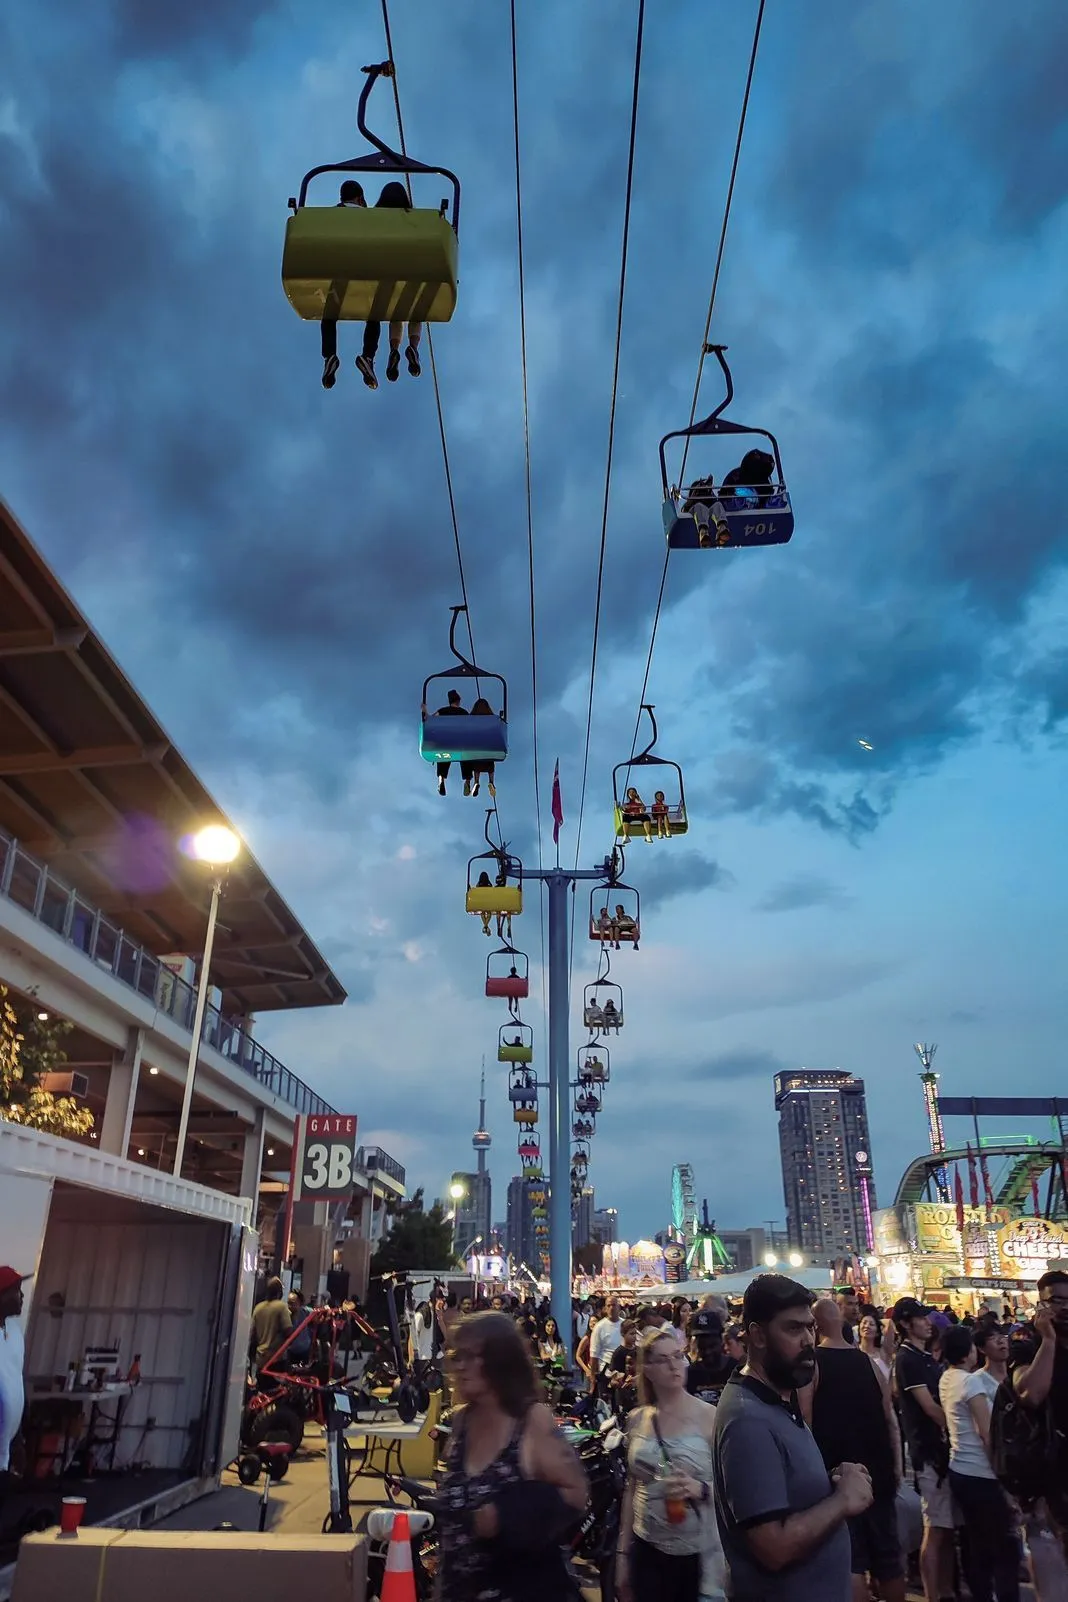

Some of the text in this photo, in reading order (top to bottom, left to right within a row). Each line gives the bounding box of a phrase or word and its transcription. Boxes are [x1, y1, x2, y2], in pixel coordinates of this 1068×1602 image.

[744, 522, 776, 536] 104
[311, 1119, 352, 1131] GATE
[304, 1144, 352, 1188] 3B
